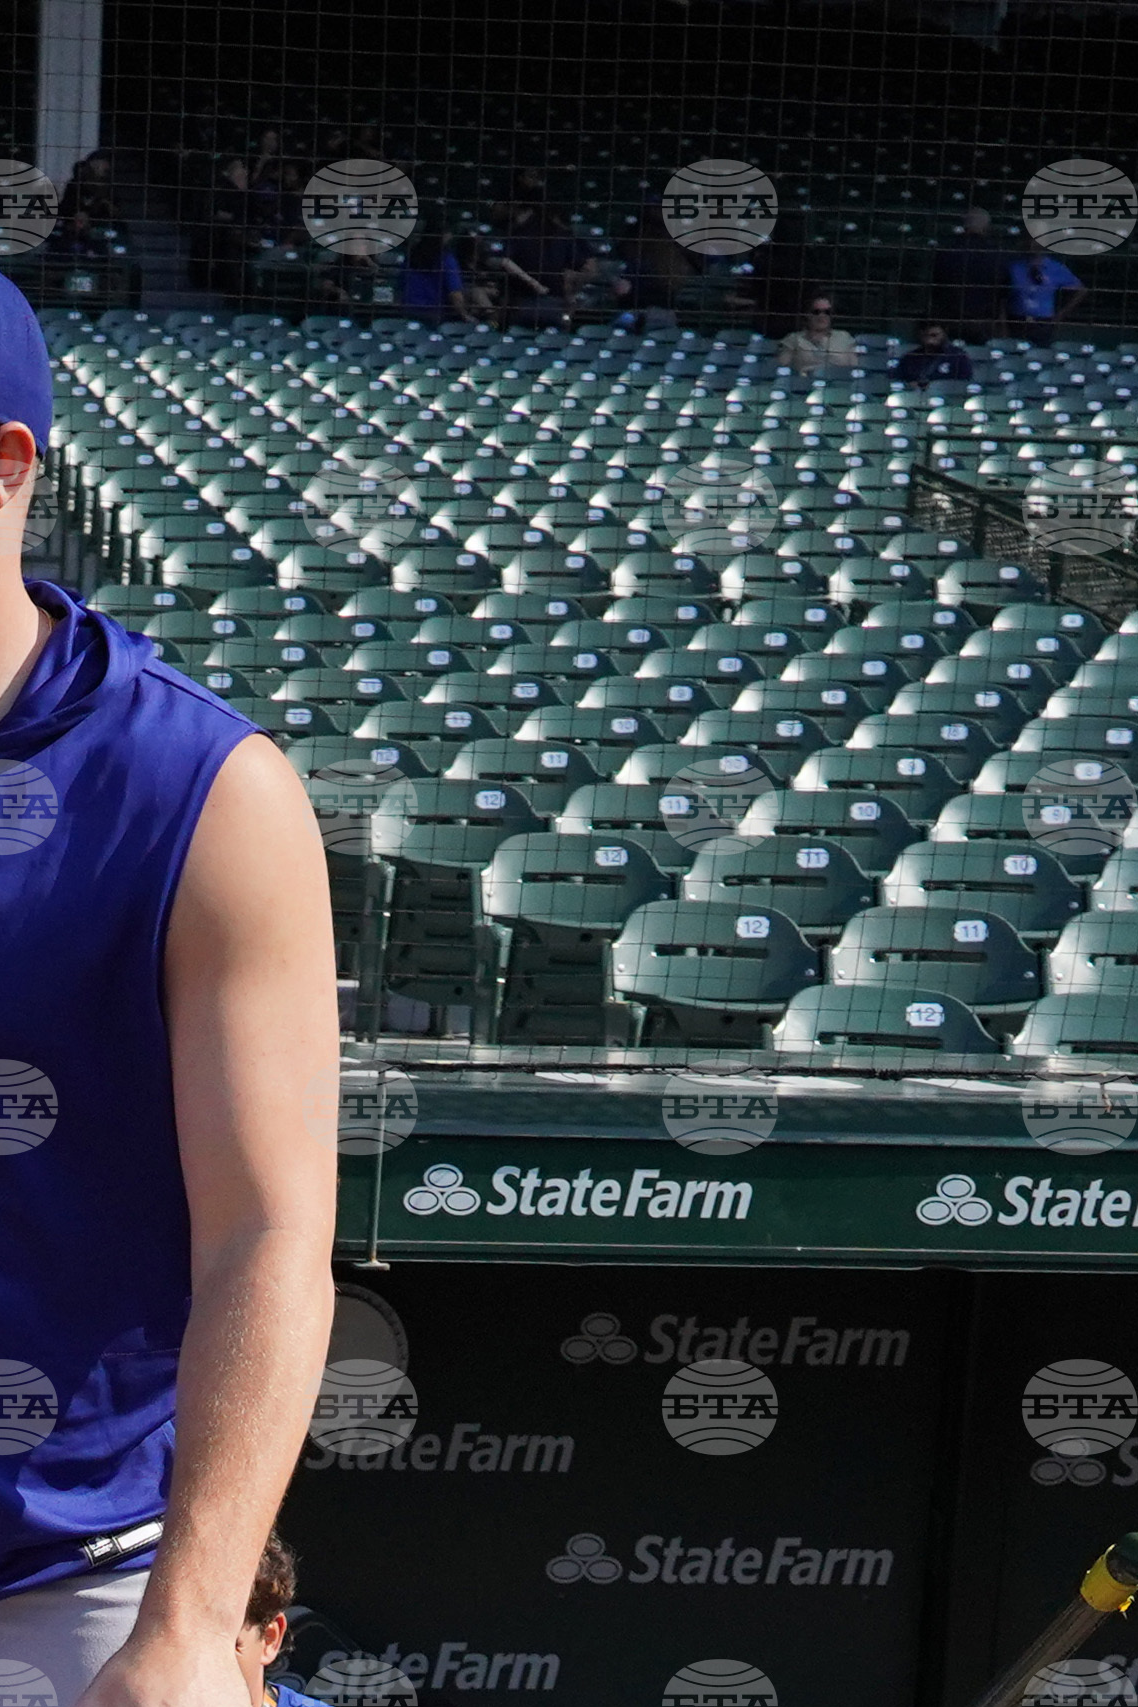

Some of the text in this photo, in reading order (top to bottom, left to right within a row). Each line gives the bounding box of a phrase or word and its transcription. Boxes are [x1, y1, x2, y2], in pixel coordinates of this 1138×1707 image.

[743, 920, 762, 934] 12
[962, 925, 978, 937] 11
[915, 1007, 936, 1022] 12
[997, 1175, 1138, 1228] State
